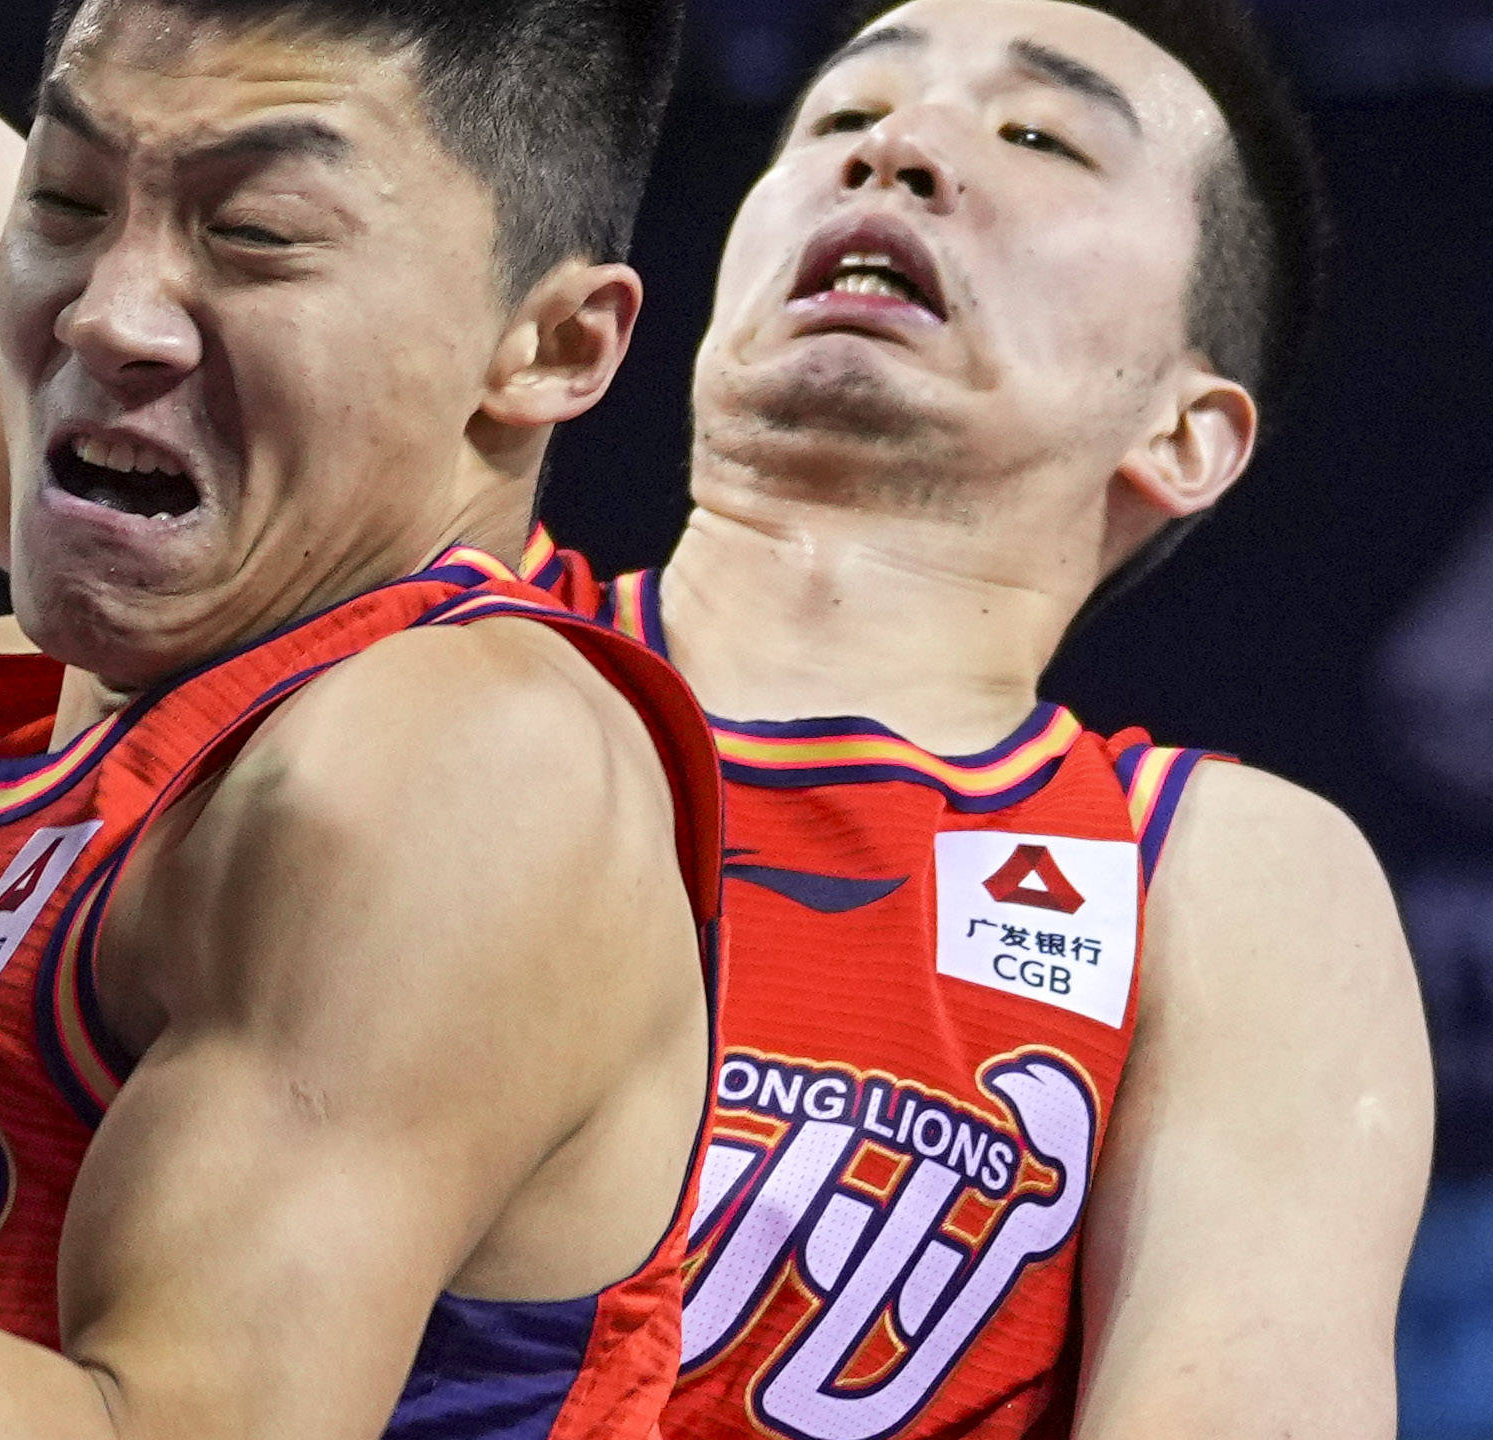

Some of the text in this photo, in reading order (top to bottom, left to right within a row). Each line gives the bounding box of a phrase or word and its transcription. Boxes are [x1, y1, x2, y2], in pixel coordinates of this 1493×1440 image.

[966, 918, 1102, 966] 广发银行
[992, 953, 1072, 995] CGB
[716, 1060, 1014, 1191] ONG LIONS
